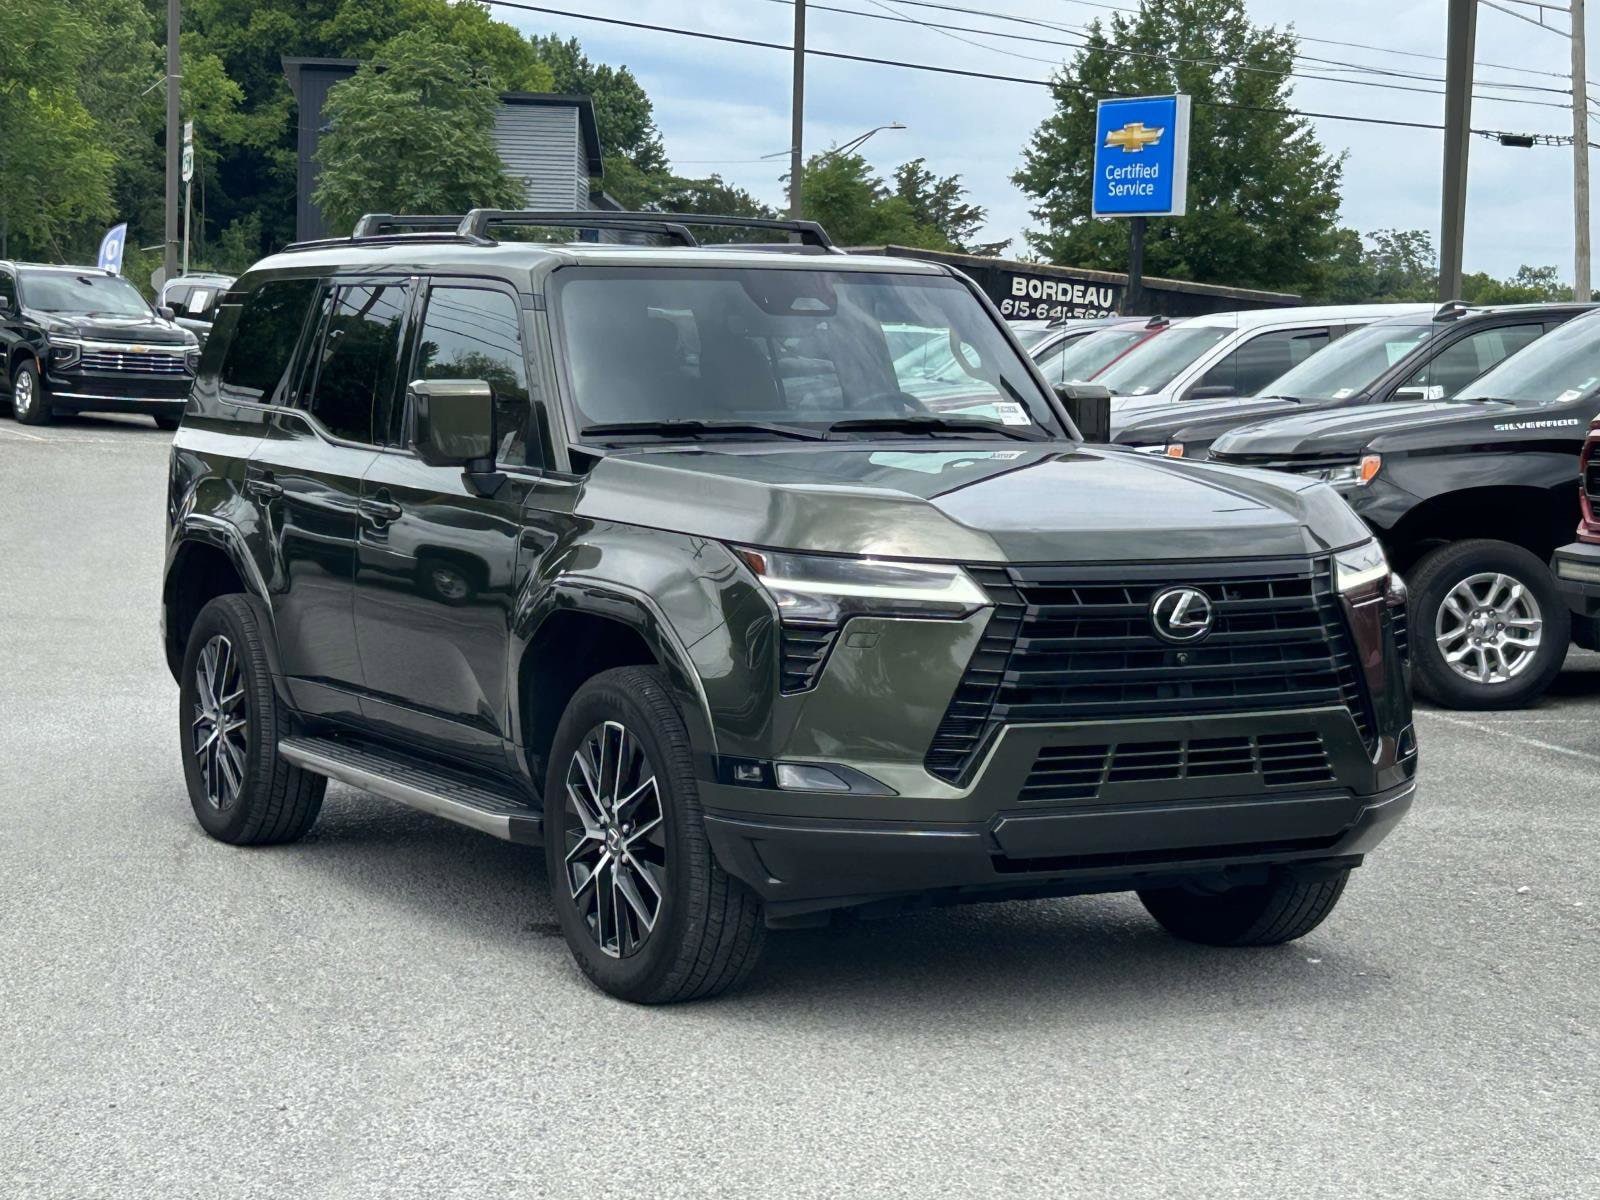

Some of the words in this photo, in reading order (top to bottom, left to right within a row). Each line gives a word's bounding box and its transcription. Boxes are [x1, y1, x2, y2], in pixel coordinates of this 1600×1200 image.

[1105, 163, 1159, 179] Certified
[1108, 181, 1154, 196] Service
[1012, 277, 1112, 308] BORDEAU
[1493, 418, 1579, 431] SILVERADO
